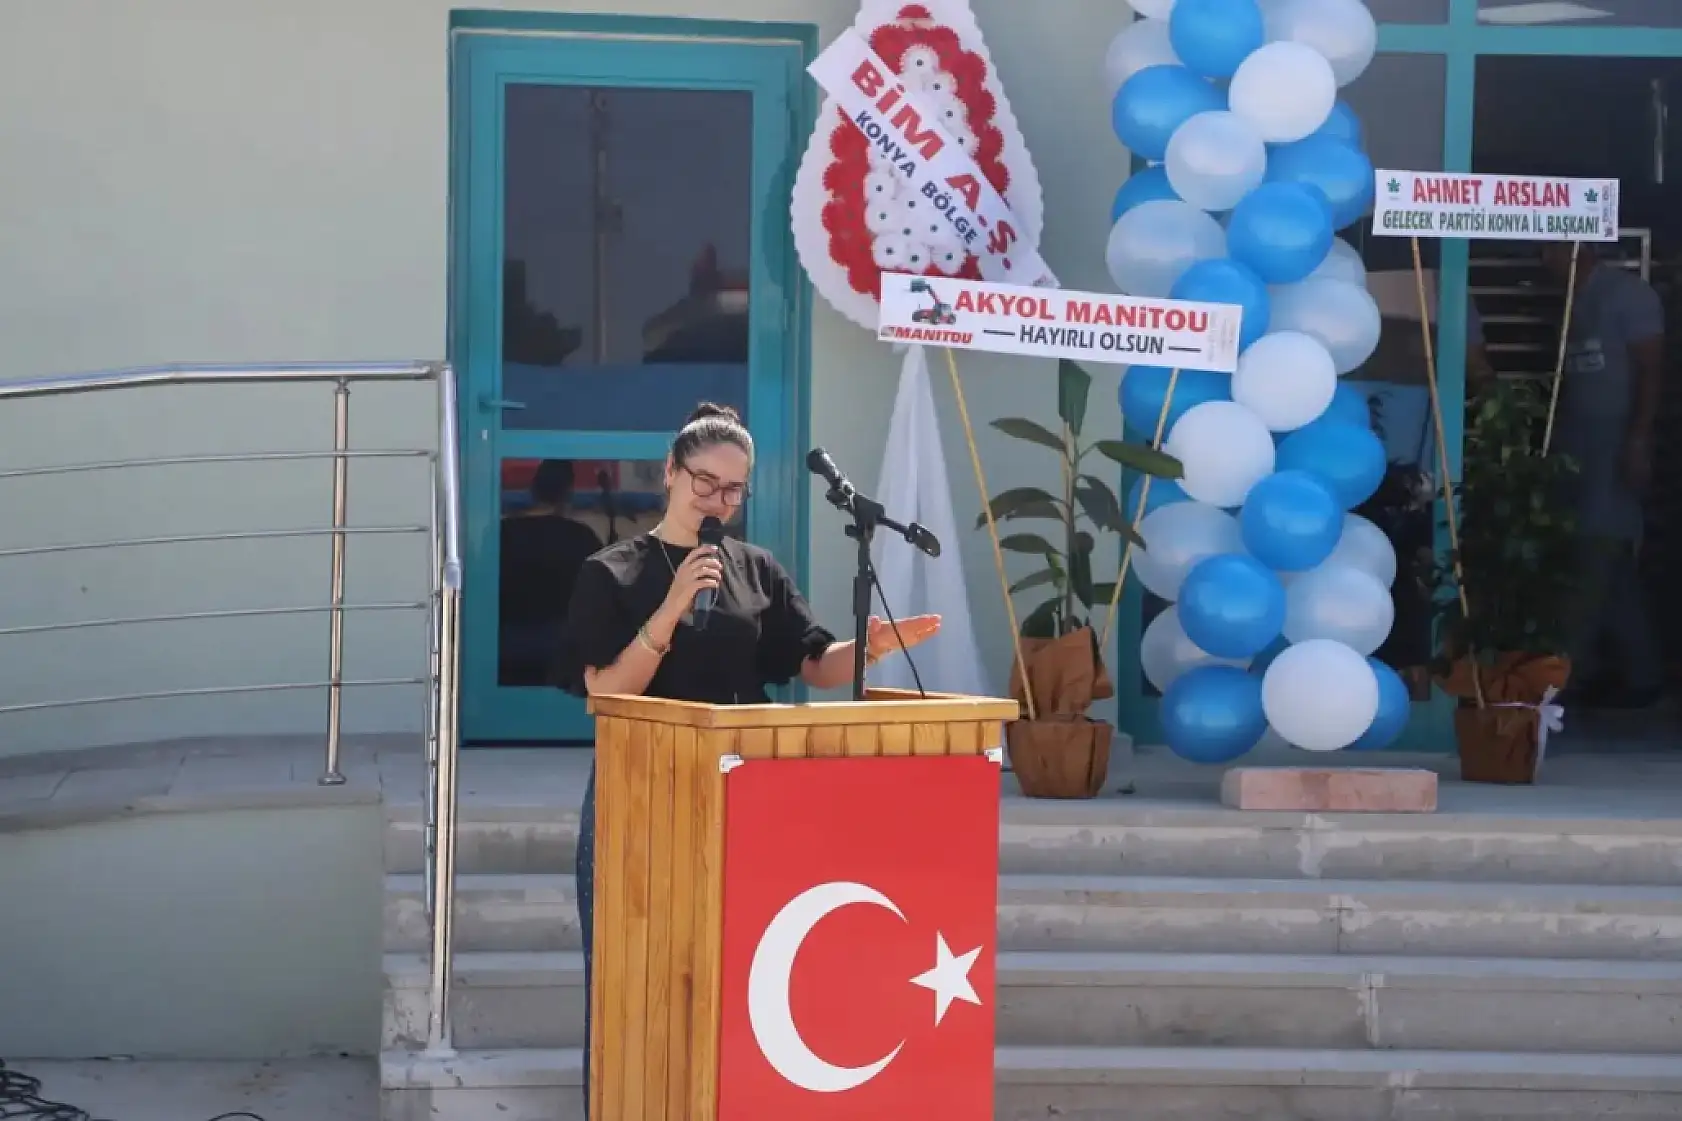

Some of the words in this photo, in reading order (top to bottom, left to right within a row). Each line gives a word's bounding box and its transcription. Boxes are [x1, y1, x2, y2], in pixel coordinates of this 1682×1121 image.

[852, 58, 945, 160] BİM
[855, 110, 916, 178] KONYA
[920, 180, 979, 245] BÖLGE
[1412, 177, 1483, 205] AHMET
[1493, 180, 1571, 208] ARSLAN
[1382, 209, 1433, 230] GELECEK
[1439, 208, 1485, 232] PARTİSİ
[1488, 212, 1529, 233] KONYA
[1532, 209, 1544, 233] İL
[1547, 214, 1600, 239] BAŞKANI
[954, 290, 1056, 320] AKYOL
[894, 326, 974, 344] MANITOU
[1020, 324, 1094, 349] HAYIRLI
[1099, 331, 1165, 355] OLSUN
